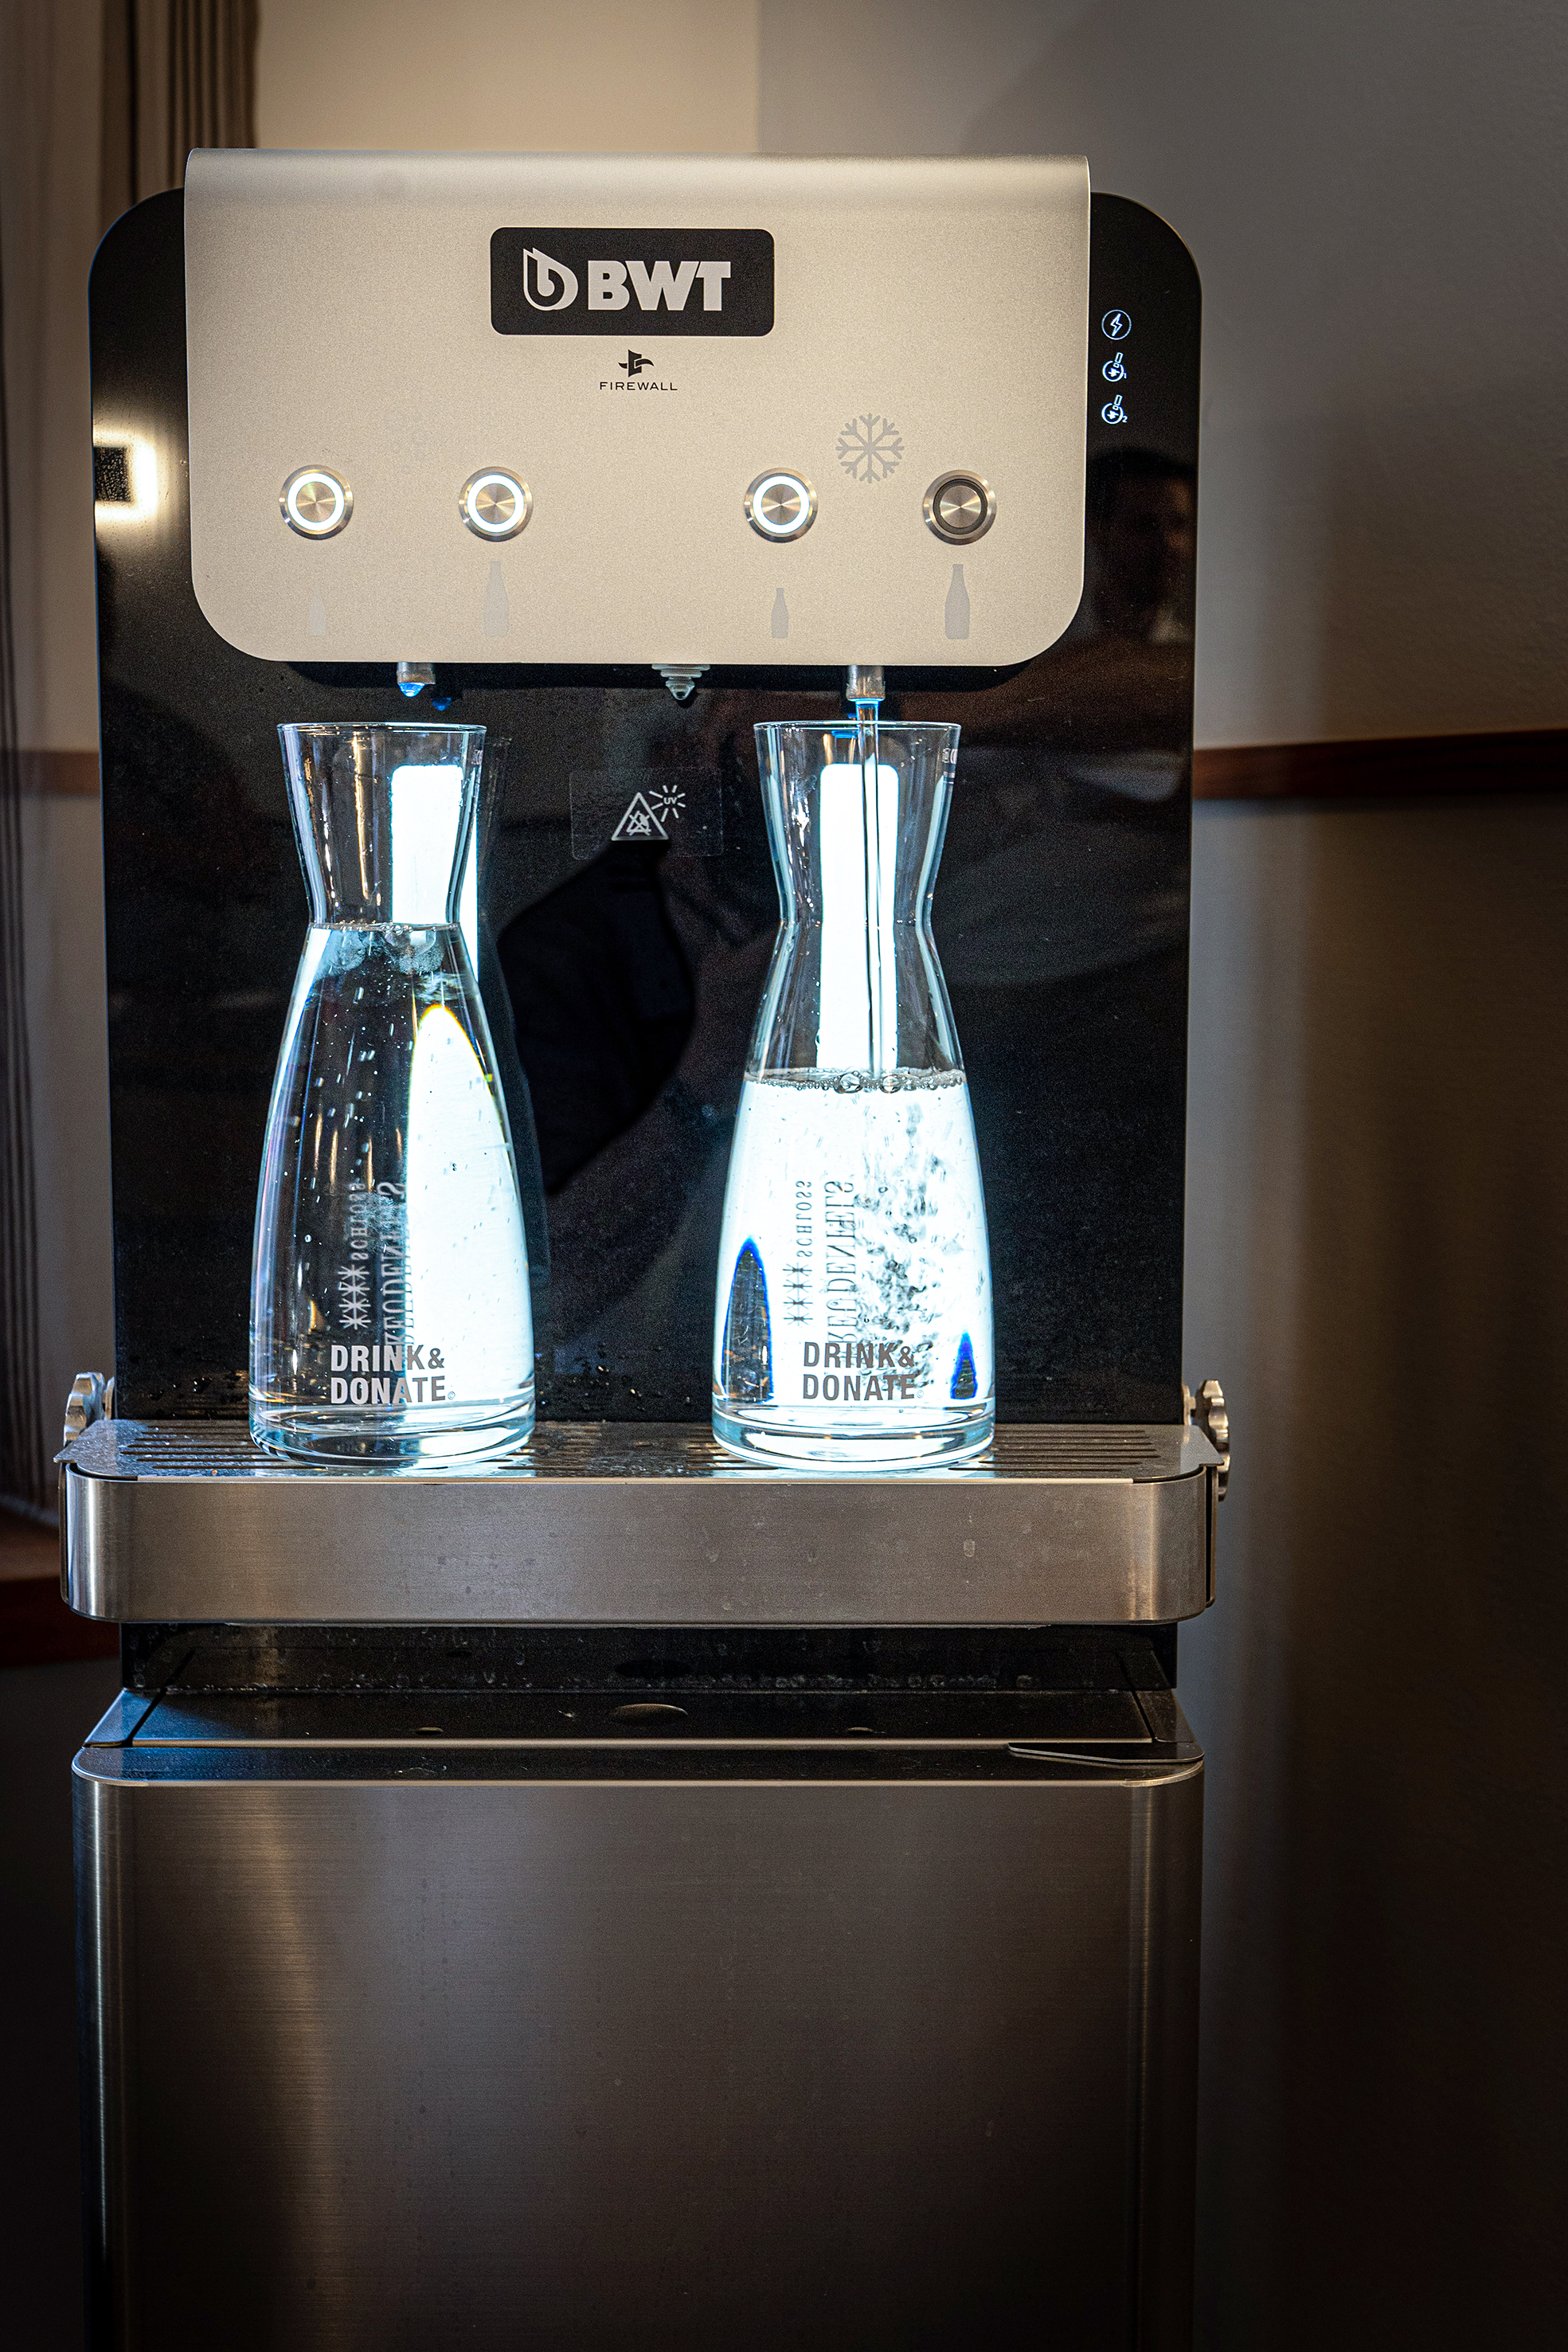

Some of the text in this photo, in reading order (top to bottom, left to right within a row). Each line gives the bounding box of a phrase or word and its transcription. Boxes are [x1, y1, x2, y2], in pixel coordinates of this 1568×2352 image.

[588, 260, 731, 311] BWT
[599, 381, 678, 391] FIREWALL
[330, 1344, 445, 1372] DRINK&
[804, 1341, 915, 1368] DRINK&
[330, 1375, 446, 1405] DONATE
[803, 1373, 915, 1401] DONATE
